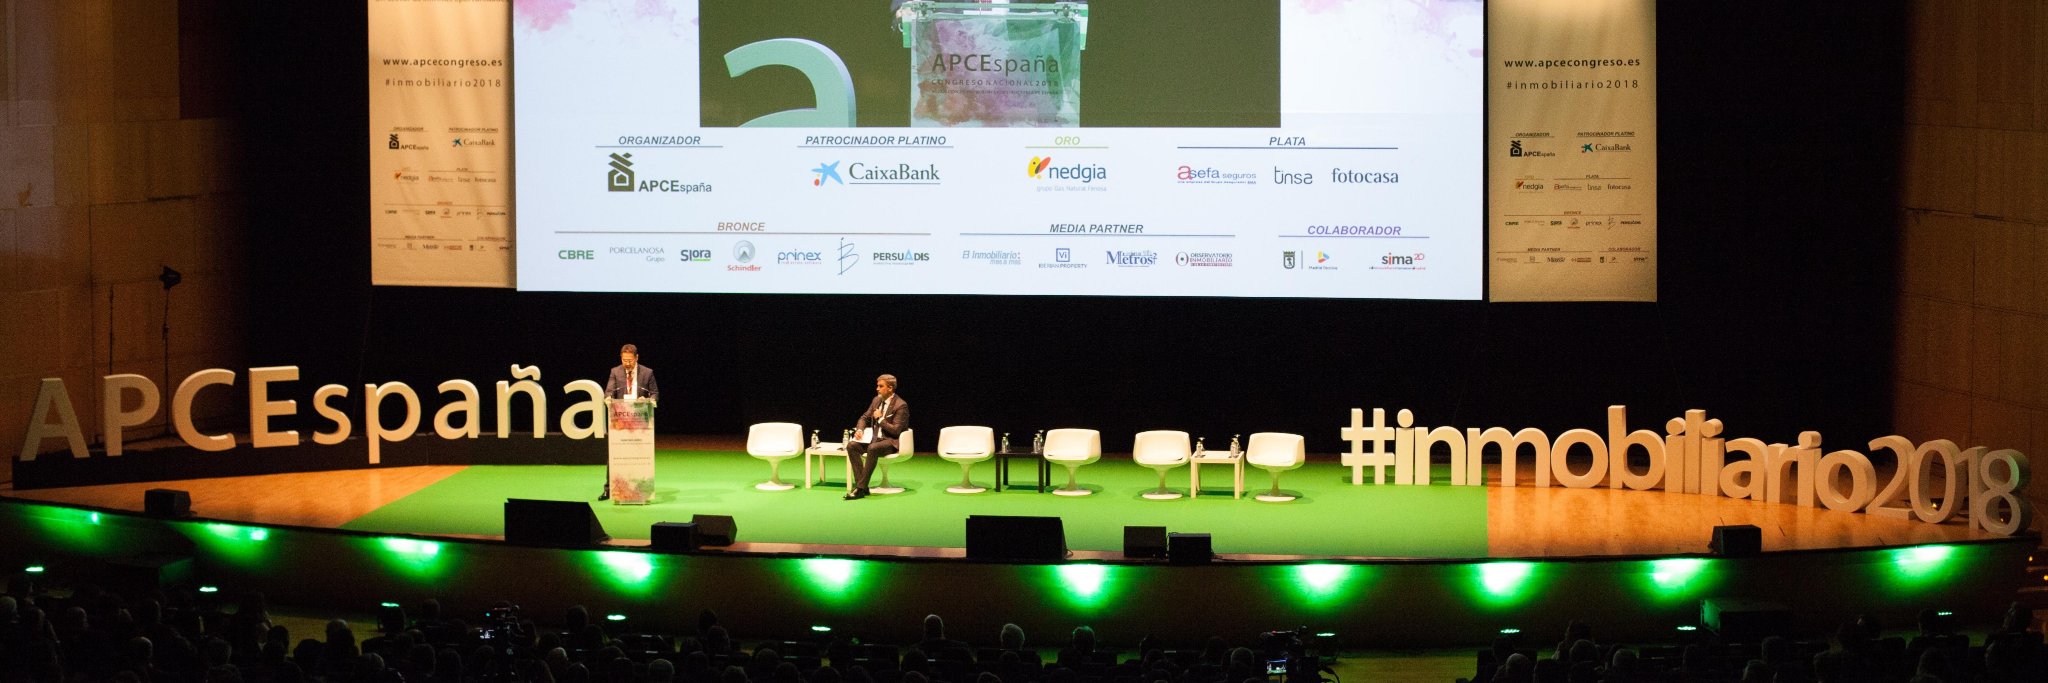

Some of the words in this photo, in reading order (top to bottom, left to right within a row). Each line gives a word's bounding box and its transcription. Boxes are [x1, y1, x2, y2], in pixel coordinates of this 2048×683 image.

[383, 57, 503, 69] www.apcecongreso.es
[932, 53, 1060, 77] APCEspaña
[1504, 57, 1641, 69] www.apcecongreso.es
[385, 78, 501, 88] #inmobiliario2018
[1506, 79, 1639, 90] #inmobiliario2018
[618, 136, 701, 145] ORGANIZADOR
[805, 136, 894, 145] PATROCINADOR
[897, 136, 947, 146] PLATINO
[1054, 136, 1081, 146] ORO
[1269, 136, 1307, 146] PLATA
[1595, 143, 1631, 151] CaixaBank
[849, 162, 941, 180] CaixaBank
[1049, 163, 1107, 183] nedgia
[1177, 165, 1220, 181] asefa
[1274, 166, 1313, 185] tinsa
[1331, 167, 1399, 184] fotocasa
[638, 179, 713, 194] APCEspaña
[717, 222, 765, 232] BRONCE
[1050, 224, 1086, 233] MEDIA
[1089, 224, 1144, 233] PARTNER
[1307, 226, 1402, 236] COLABORADOR
[558, 250, 594, 260] CBRE
[777, 249, 822, 265] prinex
[873, 249, 930, 261] PERSUADIS
[1382, 252, 1413, 265] sima
[19, 364, 608, 464] APCEspaña
[1341, 404, 2032, 536] #inmobiliario2018
